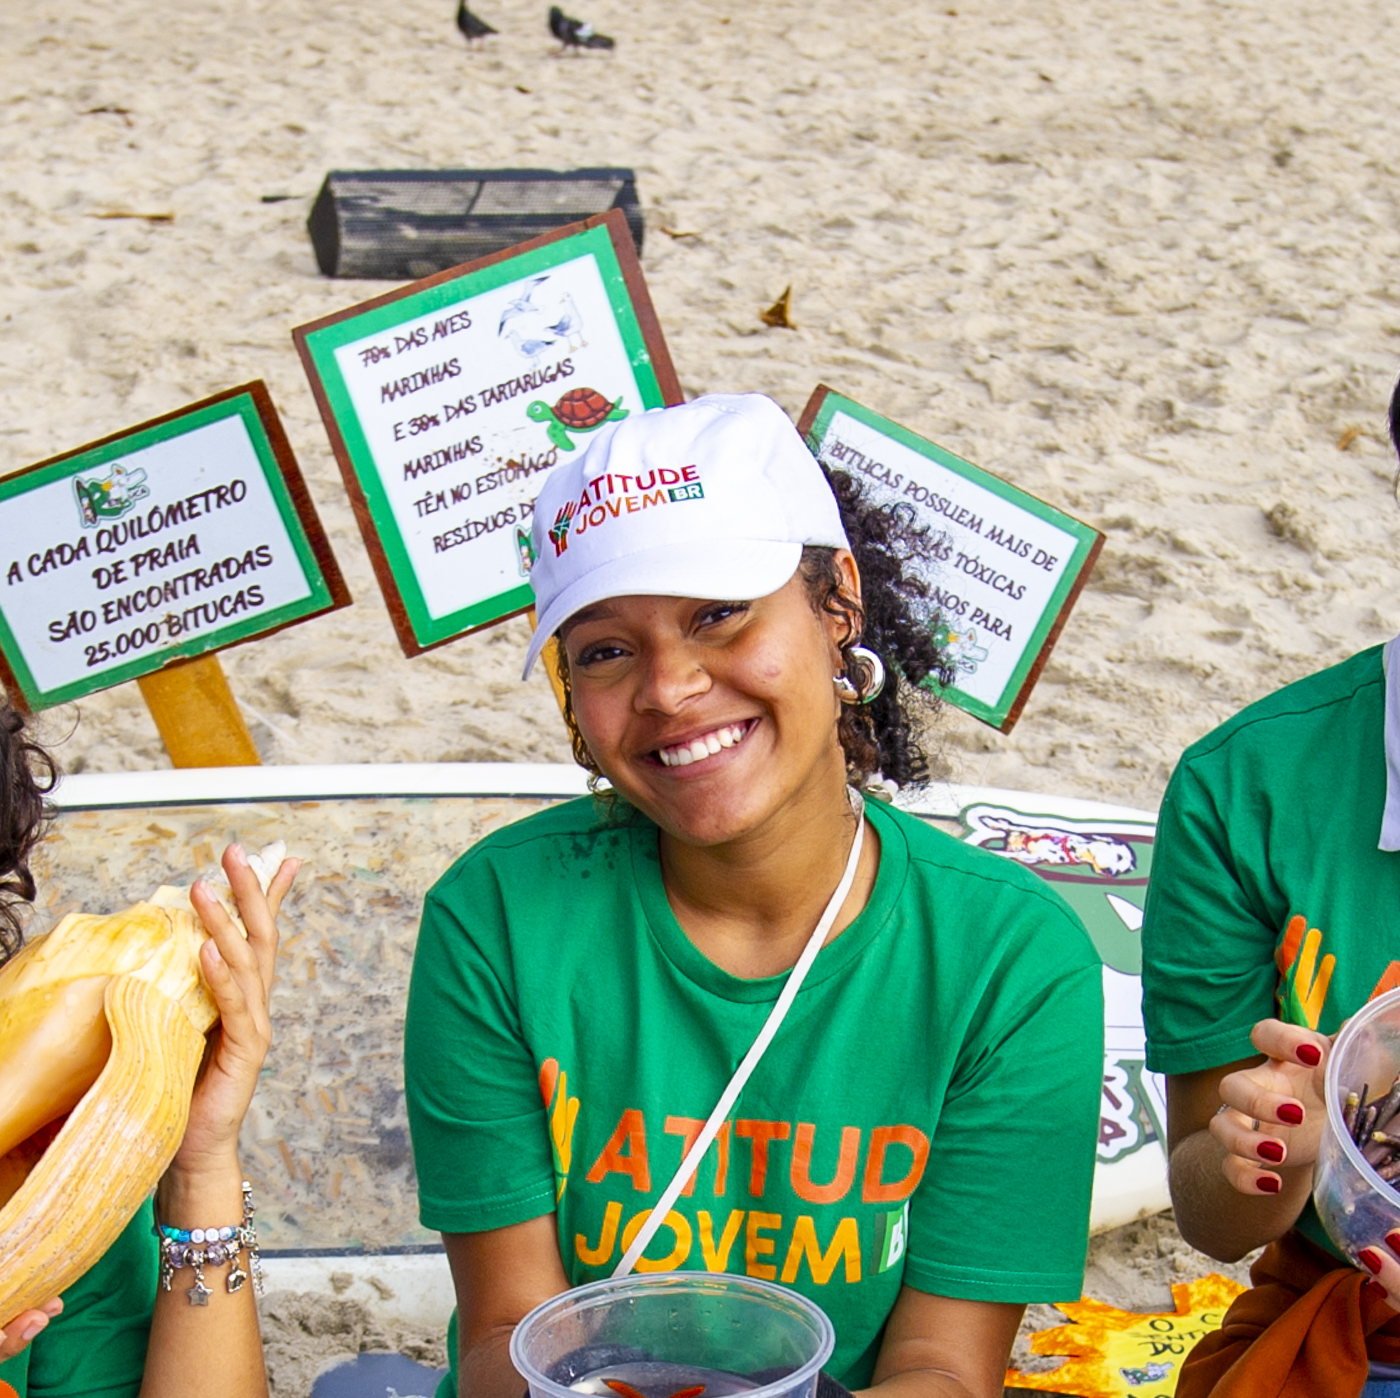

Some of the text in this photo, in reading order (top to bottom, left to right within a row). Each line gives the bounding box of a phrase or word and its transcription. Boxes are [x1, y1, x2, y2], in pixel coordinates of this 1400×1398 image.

[393, 327, 429, 355] DAS
[432, 311, 472, 341] AVES
[381, 358, 462, 404] MARINHAS
[393, 422, 406, 442] E
[443, 395, 477, 422] DAS
[478, 358, 575, 408] TARTARUGAS
[403, 435, 484, 481] MARINHAS
[450, 482, 472, 505] NO
[575, 484, 703, 535] JOVEM BR
[577, 464, 701, 516] ATITUDE
[830, 440, 904, 489] BITUCAS
[904, 480, 985, 535] POSSUEM
[984, 524, 1033, 560] MAIS
[1031, 548, 1058, 573] DE
[432, 506, 517, 554] RESÍDUOS
[7, 561, 24, 586] A
[28, 536, 90, 576] CADA
[92, 533, 201, 589] DE PRAIA
[954, 554, 1028, 601] TÓXICAS
[48, 544, 274, 643] SÃO ENCONTRADAS
[84, 584, 265, 667] 25.000 BITUCAS
[969, 609, 1014, 642] PARA
[585, 1108, 930, 1204] ATITUD
[575, 1201, 862, 1286] JOVEM
